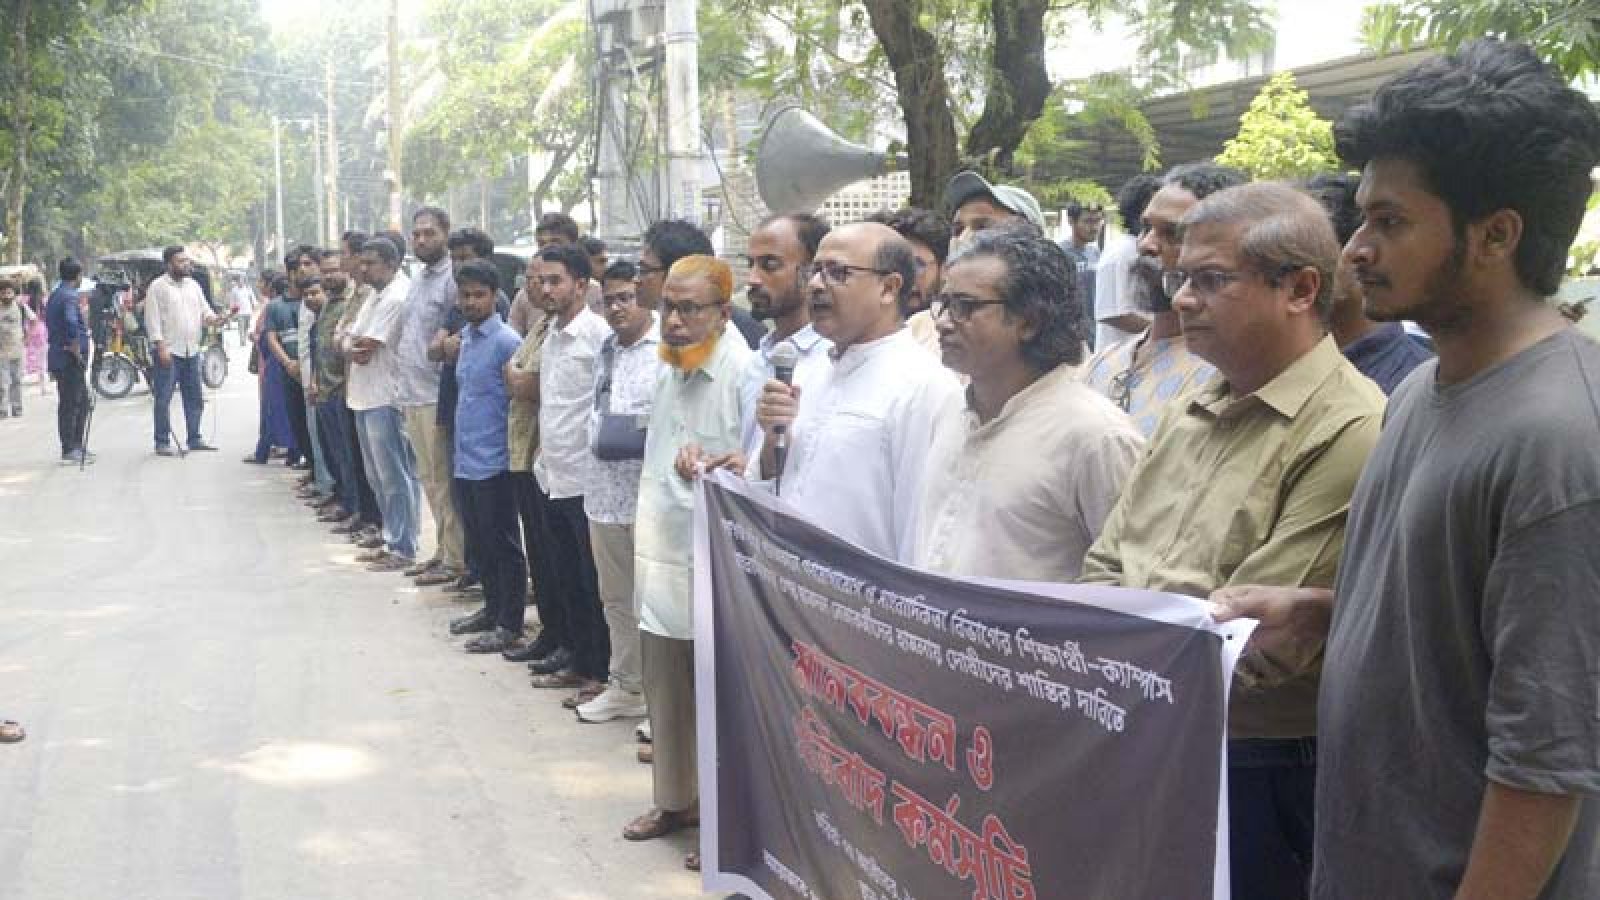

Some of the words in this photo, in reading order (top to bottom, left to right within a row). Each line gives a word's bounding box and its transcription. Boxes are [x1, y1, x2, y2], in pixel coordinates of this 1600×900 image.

[951, 607, 1012, 656] বিভাগের
[792, 640, 957, 771] মানববন্ধন
[966, 722, 993, 792] ও
[1016, 670, 1070, 709] শাস্তির
[1074, 687, 1127, 732] দাবিতে
